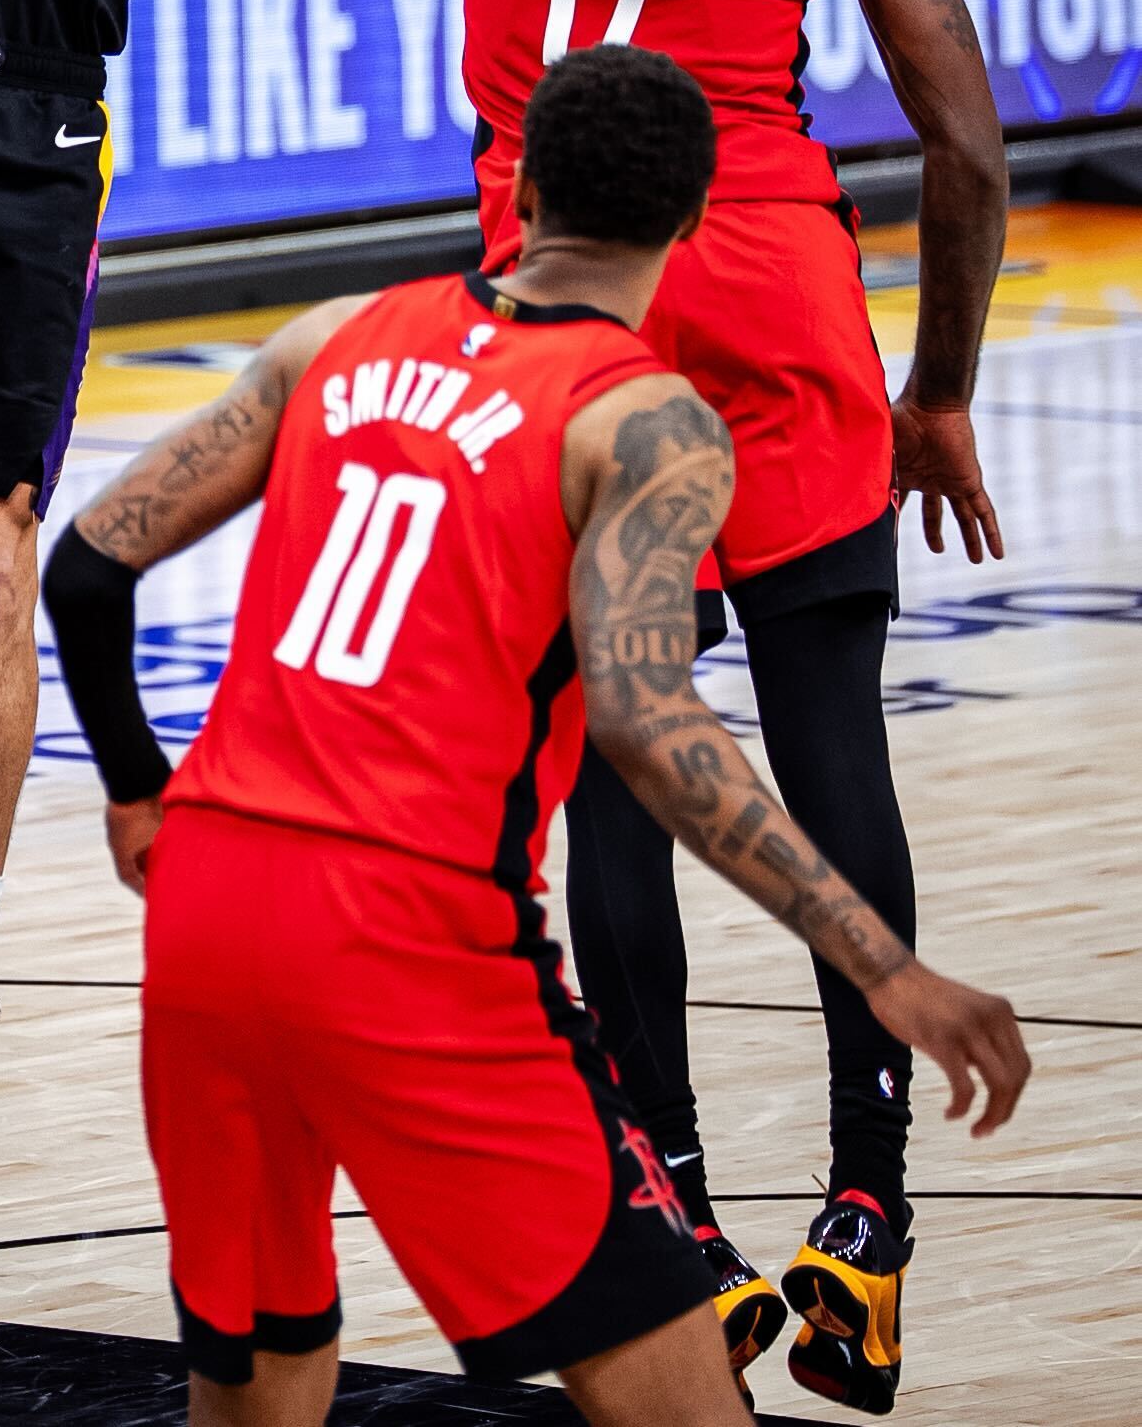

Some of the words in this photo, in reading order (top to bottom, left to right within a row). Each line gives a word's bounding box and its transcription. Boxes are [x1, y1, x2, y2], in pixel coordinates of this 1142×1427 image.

[322, 356, 472, 438] SMITH
[447, 388, 525, 475] JR.
[272, 461, 448, 688] 10
